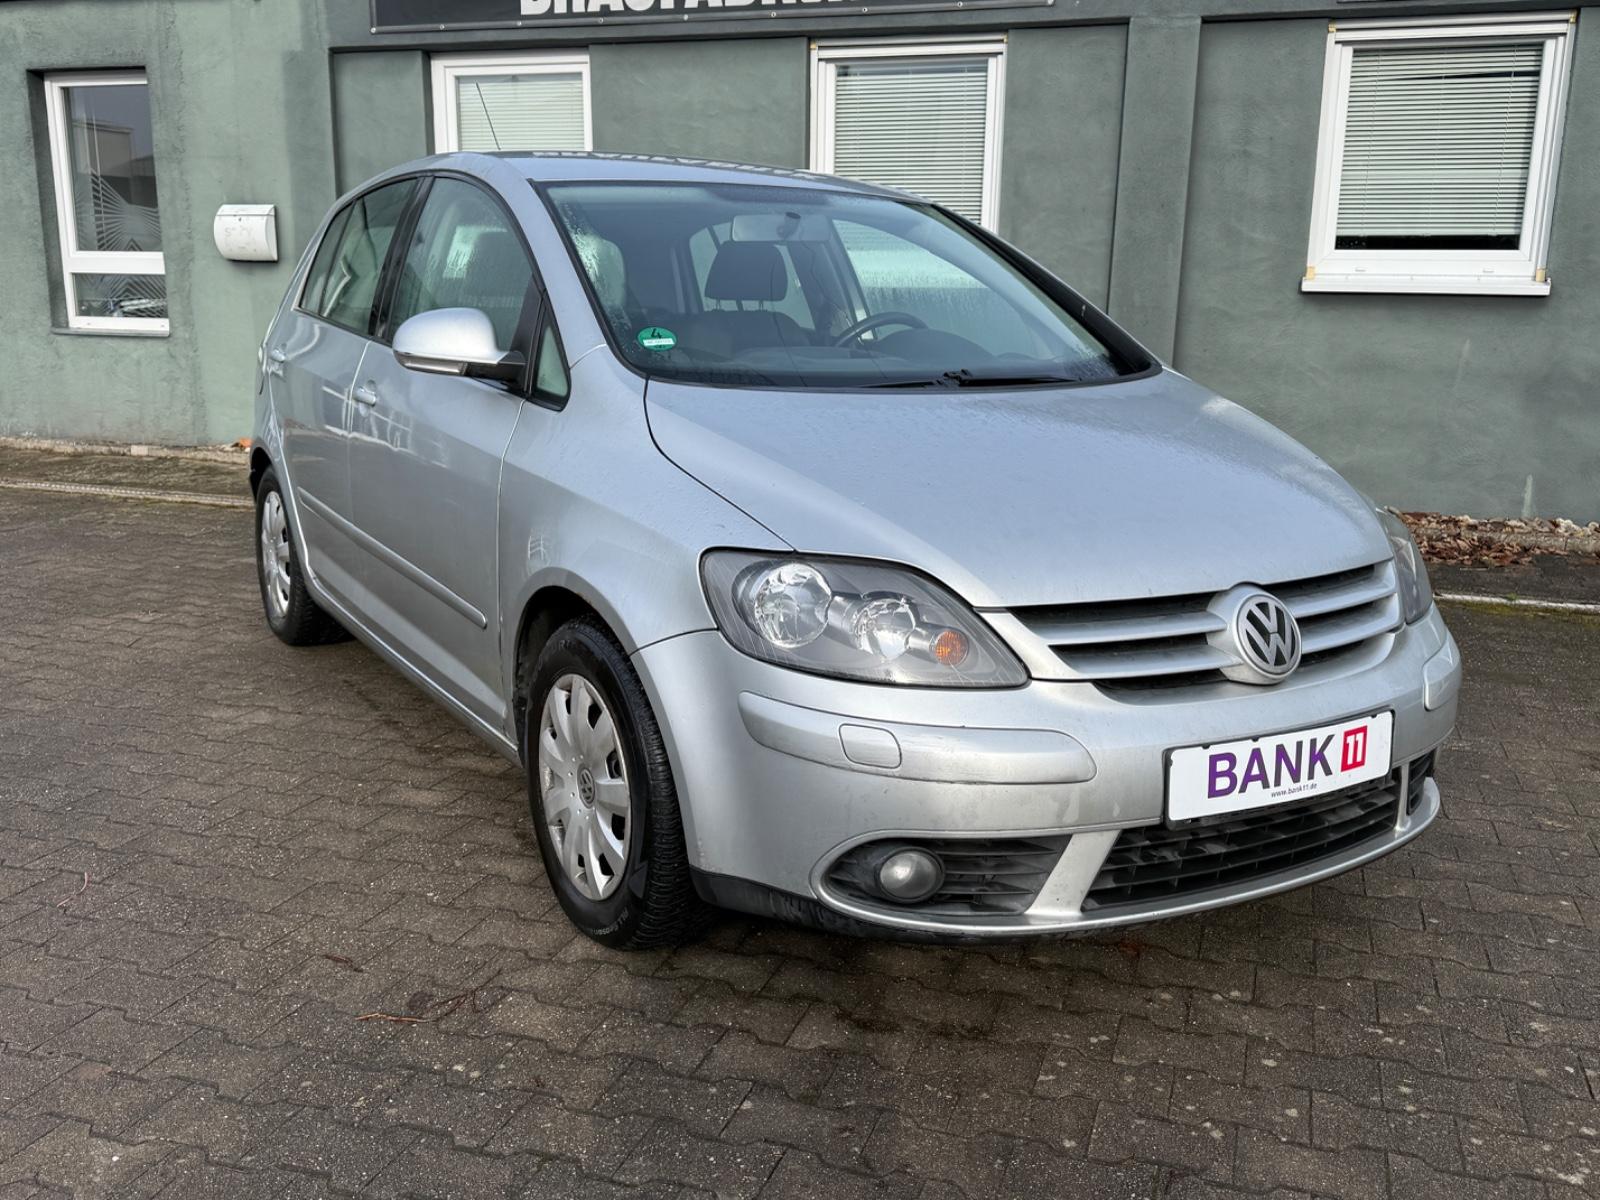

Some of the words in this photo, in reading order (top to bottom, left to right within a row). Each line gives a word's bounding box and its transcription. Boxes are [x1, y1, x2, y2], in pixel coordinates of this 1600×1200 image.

[650, 328, 662, 339] 4
[1238, 596, 1298, 672] VW
[1207, 734, 1335, 799] BANK
[1344, 730, 1366, 768] 11
[1271, 782, 1317, 797] www.bank11.de
